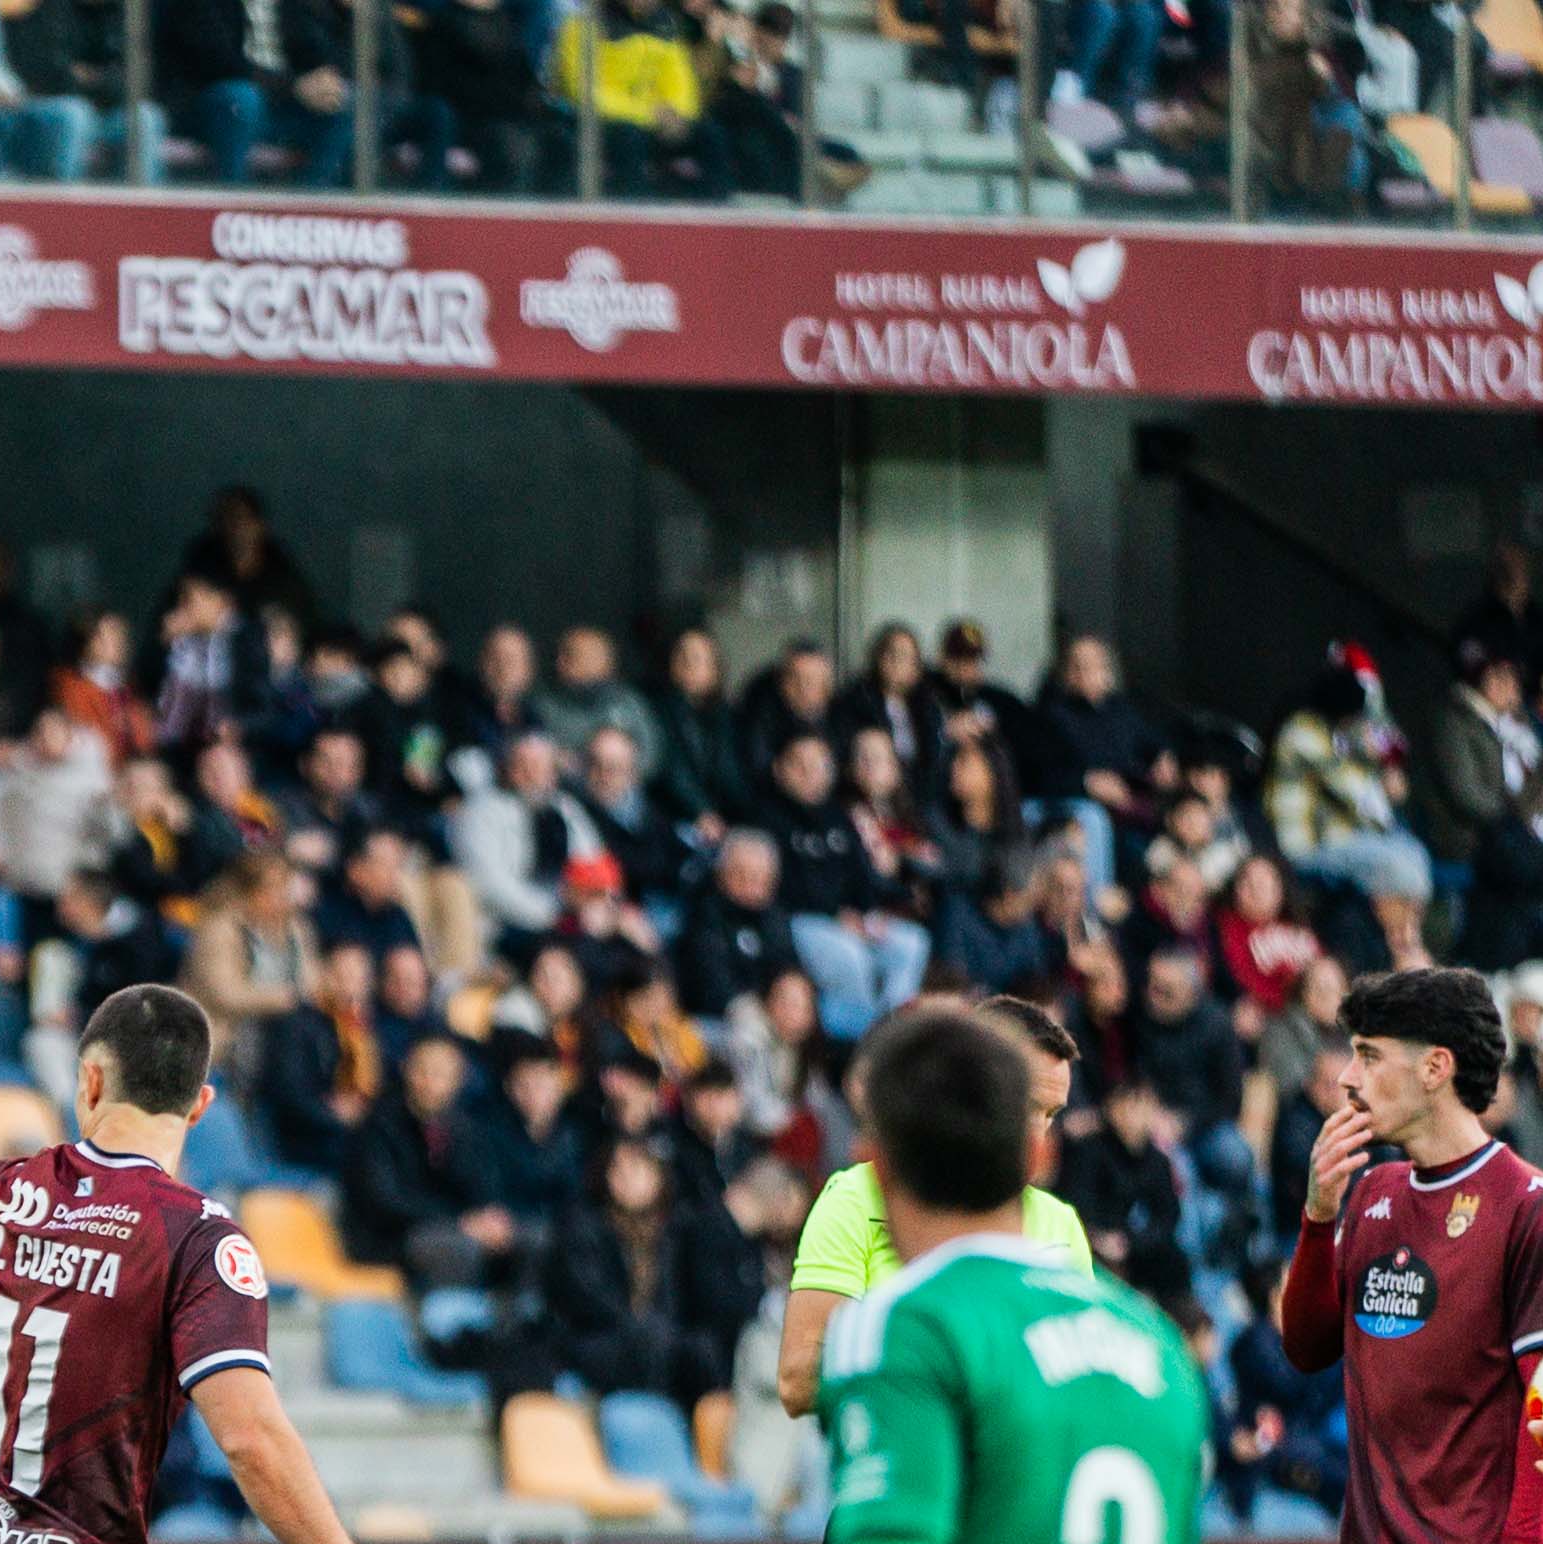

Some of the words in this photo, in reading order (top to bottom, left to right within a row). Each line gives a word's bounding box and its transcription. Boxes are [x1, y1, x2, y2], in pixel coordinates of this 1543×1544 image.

[213, 212, 407, 268] CONSERVAS
[119, 256, 494, 366] PESCAMAR
[835, 272, 934, 311] HOTEL
[940, 275, 1041, 313] RURAL
[1301, 287, 1396, 326] HOTEL
[1401, 289, 1495, 328] RURAL
[782, 317, 1136, 389] CAMPANIOLA
[14, 1234, 122, 1298] CUESTA
[1366, 1267, 1425, 1294] Estrella
[1363, 1289, 1418, 1316] Galicia
